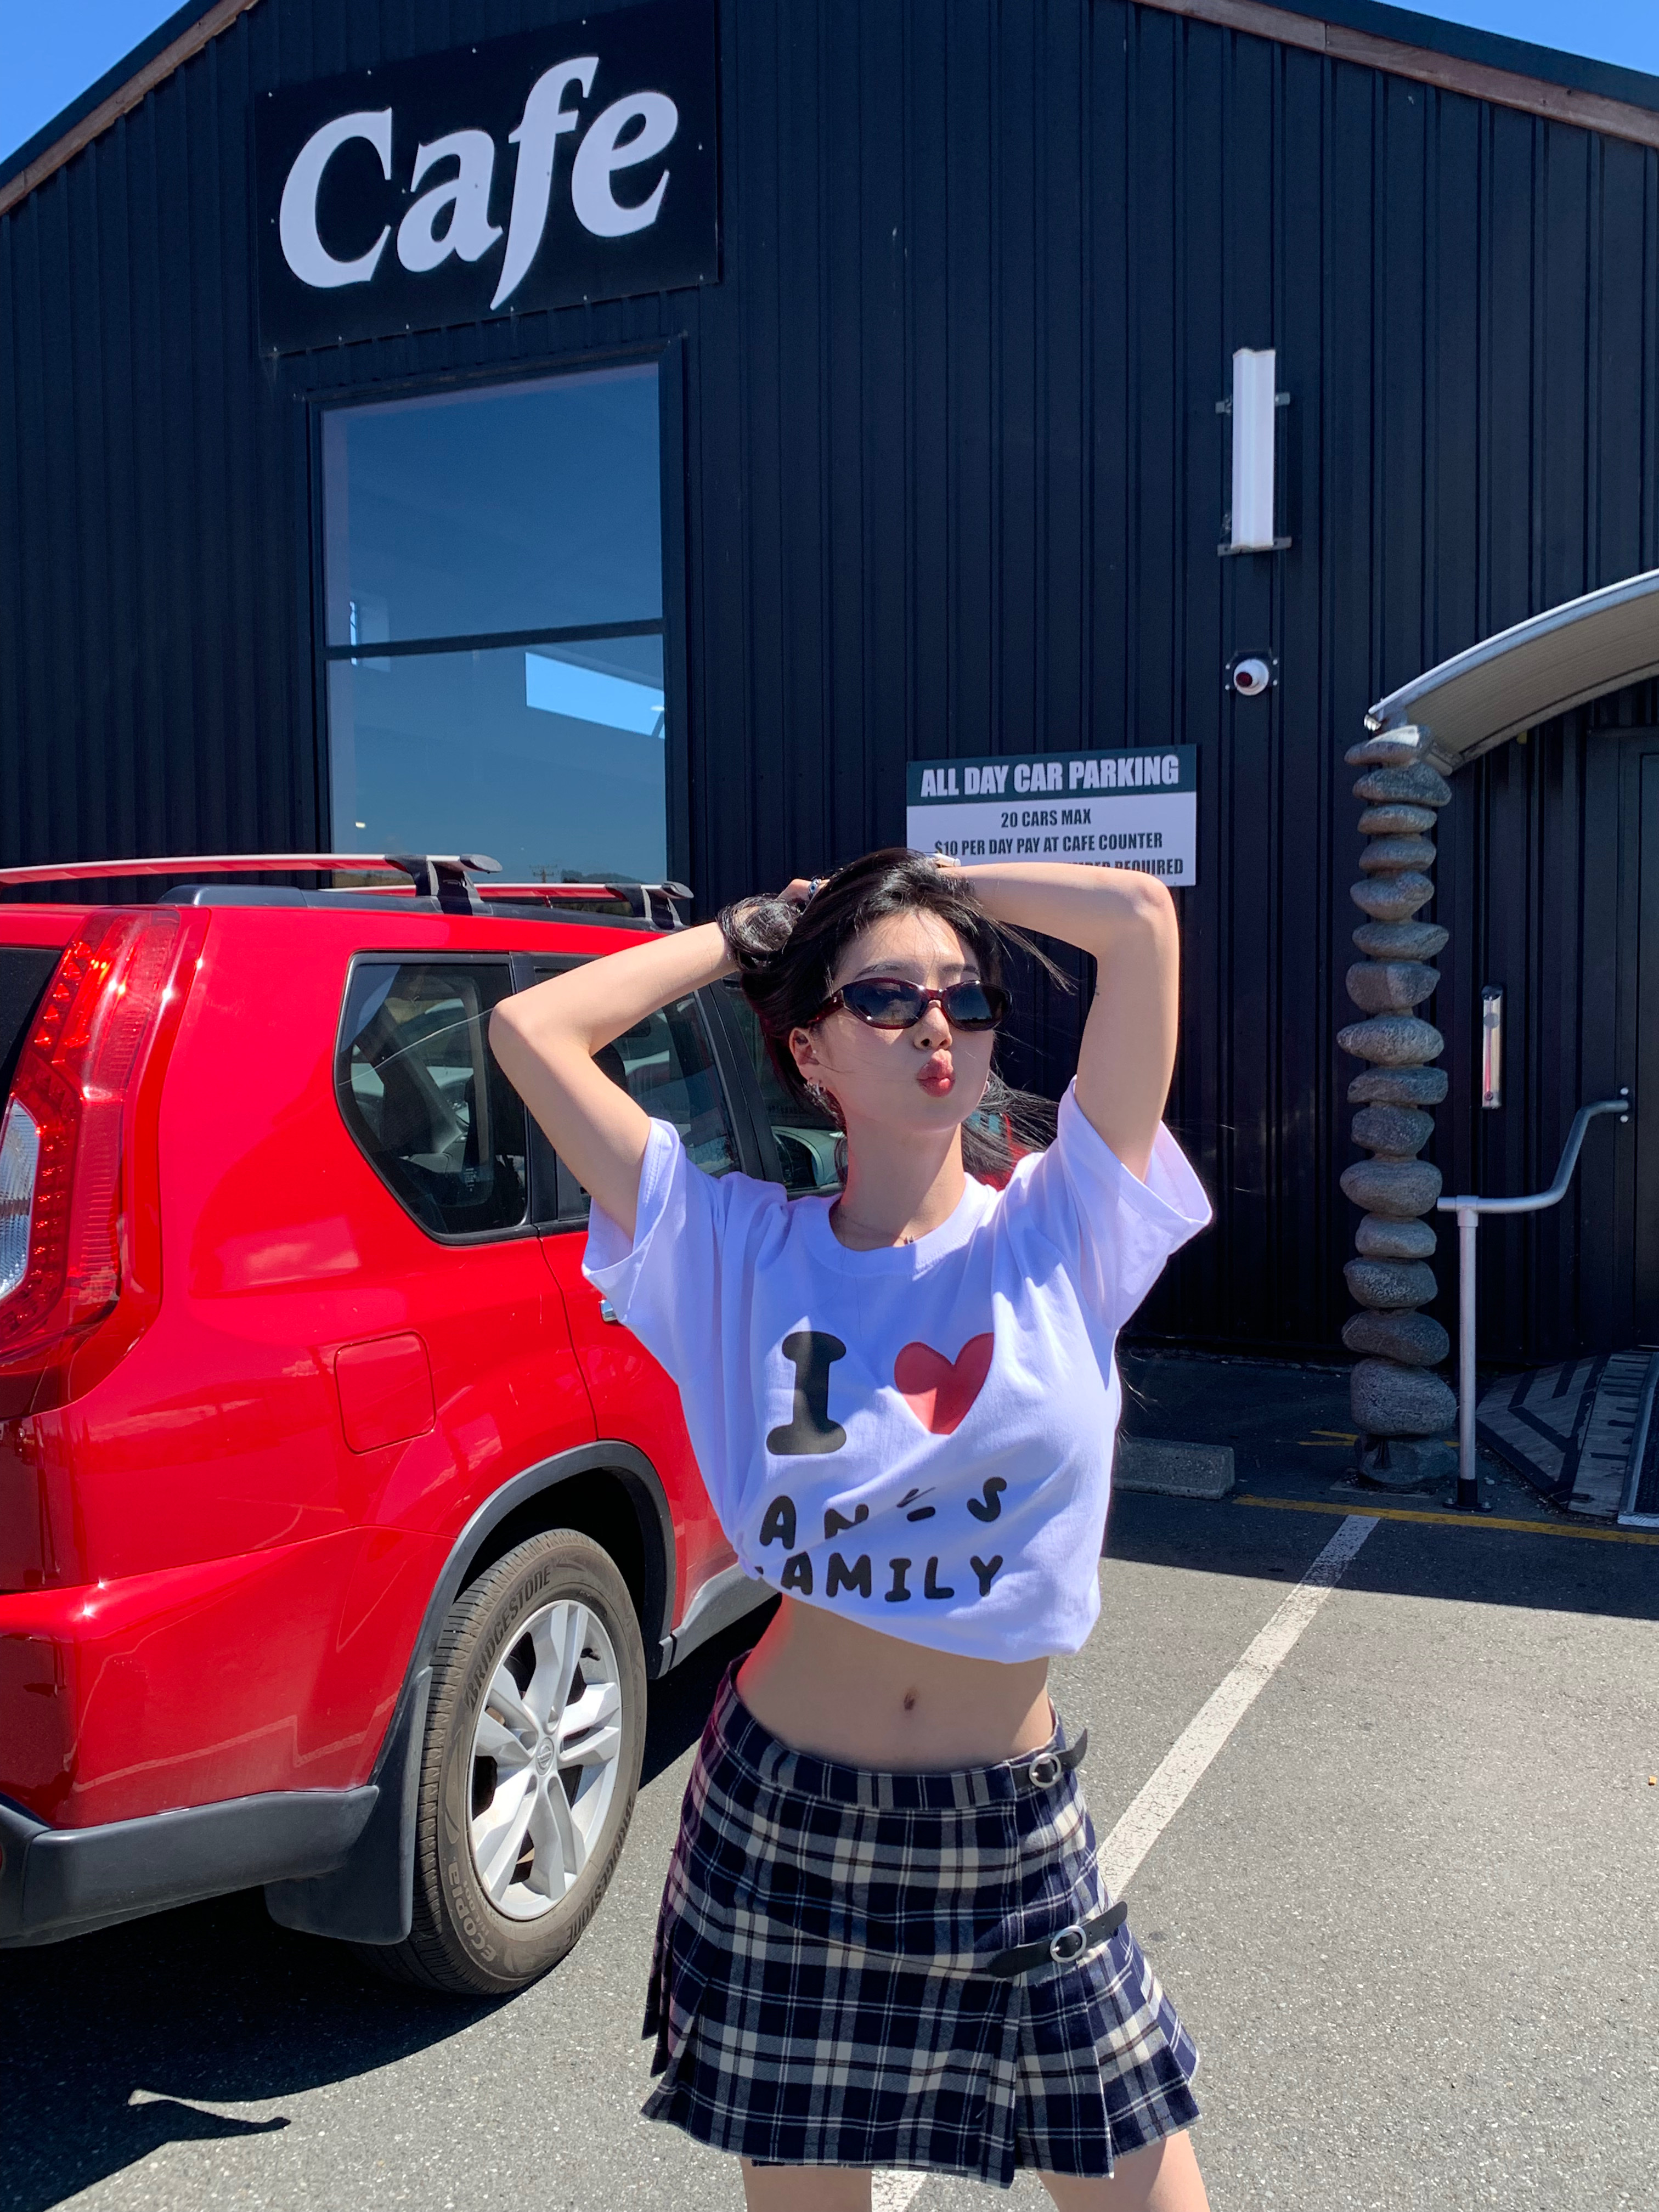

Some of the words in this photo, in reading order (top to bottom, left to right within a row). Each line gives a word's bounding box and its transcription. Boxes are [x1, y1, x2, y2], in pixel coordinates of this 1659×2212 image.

[279, 56, 679, 311] Cafe
[921, 768, 960, 797] ALL
[964, 765, 1009, 795] DAY
[1014, 761, 1063, 793] CAR
[1069, 754, 1179, 790] PARKING
[1001, 811, 1018, 828] 20
[1022, 809, 1058, 827] CARS
[1061, 808, 1091, 825] MAX
[934, 839, 958, 856] $10
[961, 839, 985, 855] PER
[989, 838, 1013, 854] DAY
[1017, 837, 1040, 854] PAY
[1043, 836, 1059, 853] AT
[1062, 834, 1095, 852] CAFE
[1098, 832, 1163, 850] COUNTER
[766, 1331, 847, 1455] I
[755, 1551, 1003, 1602] AMILY
[464, 1565, 551, 1714] BRIDGESTONE
